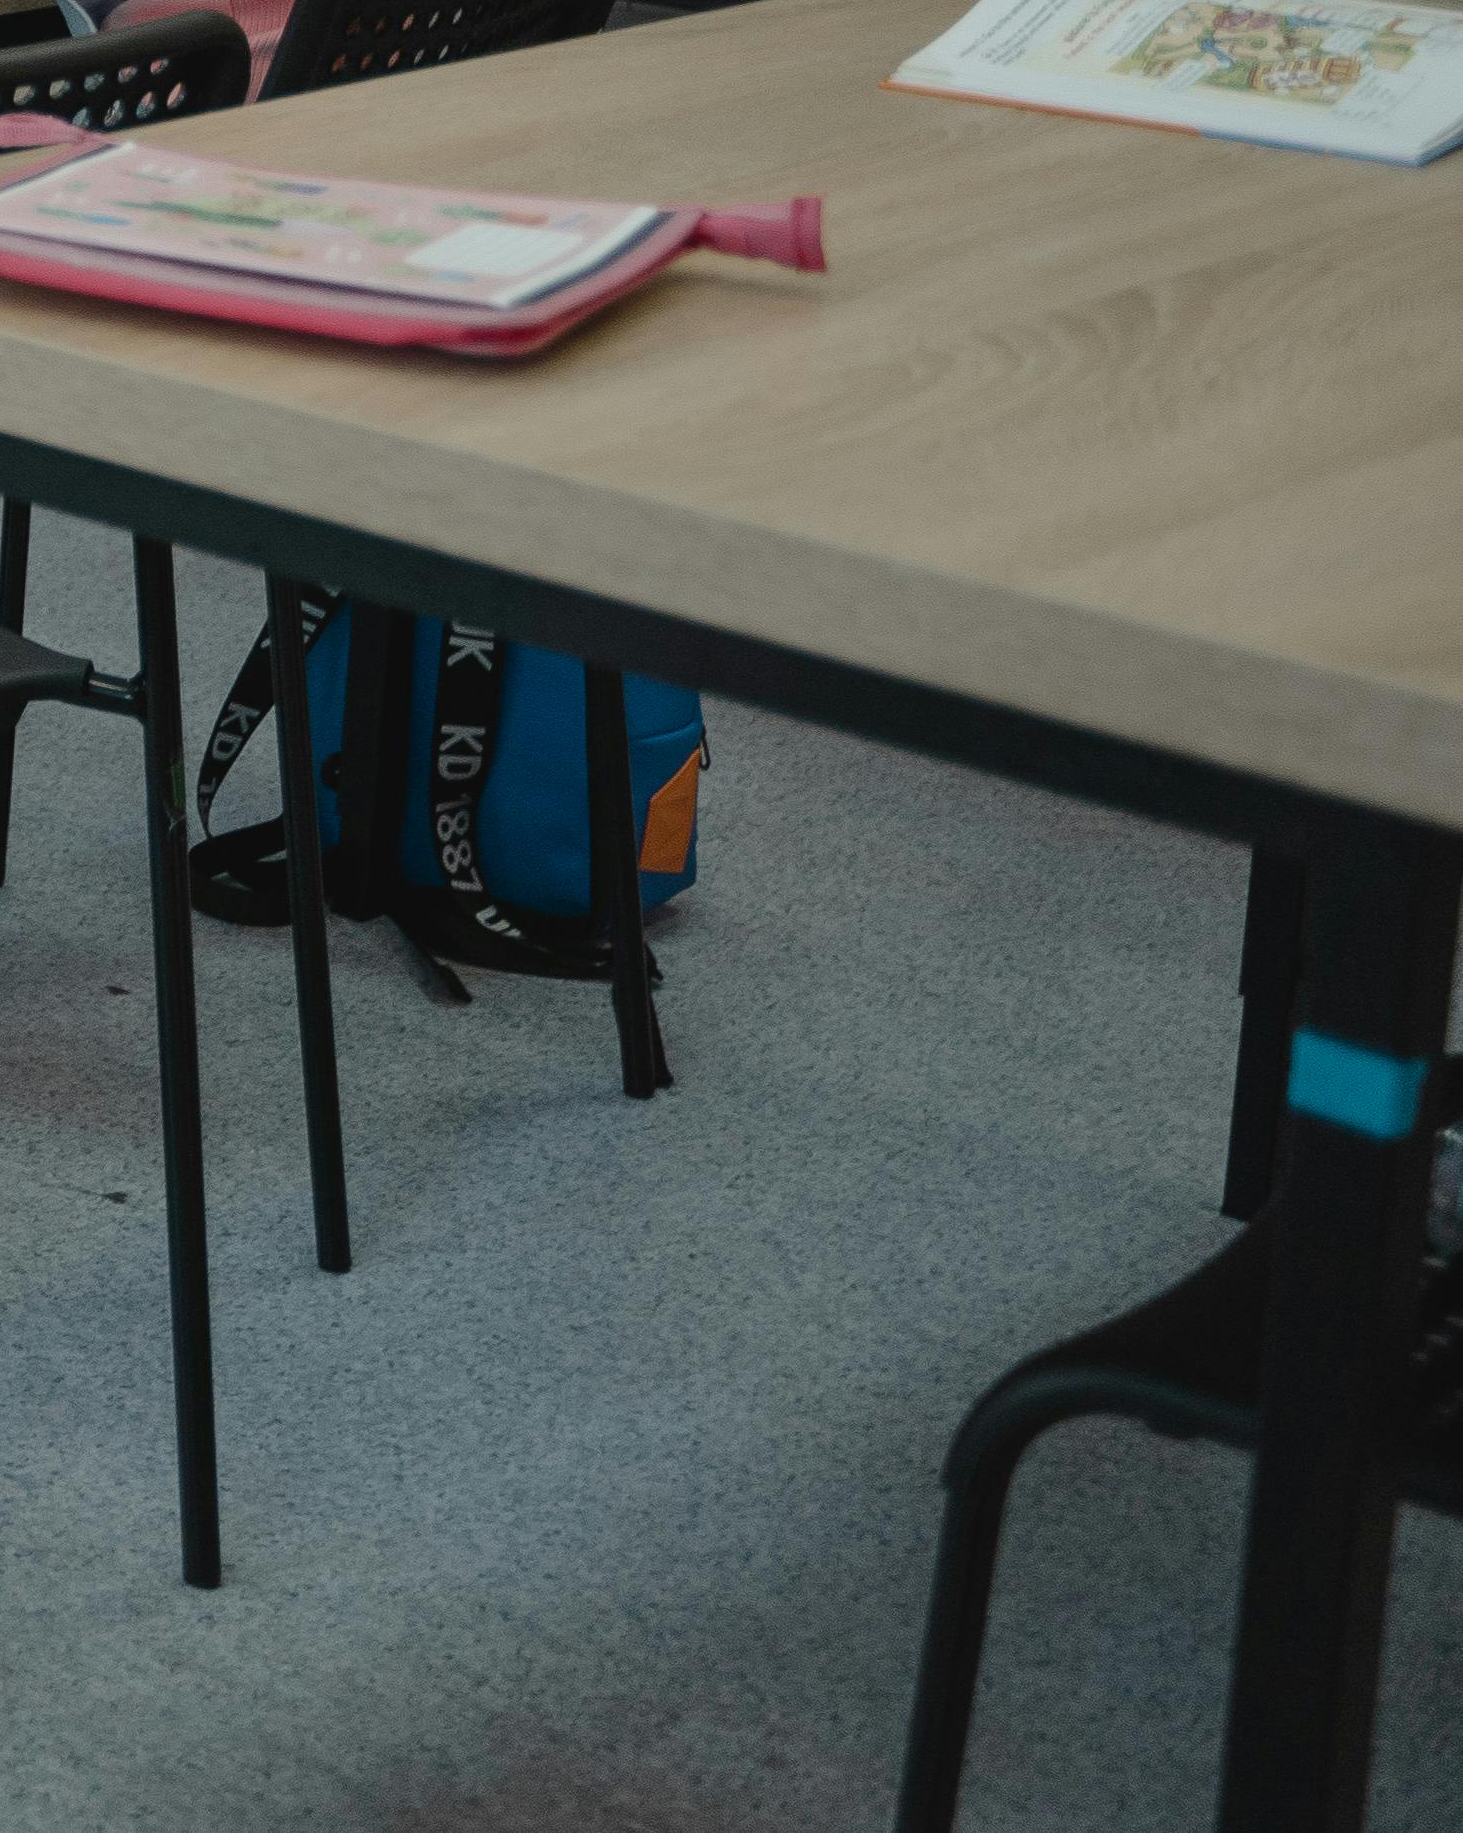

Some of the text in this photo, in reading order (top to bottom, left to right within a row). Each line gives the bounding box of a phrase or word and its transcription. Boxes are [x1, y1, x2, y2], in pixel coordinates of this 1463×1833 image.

[211, 701, 262, 762] KD
[437, 722, 487, 783] KD
[434, 791, 486, 894] 1887
